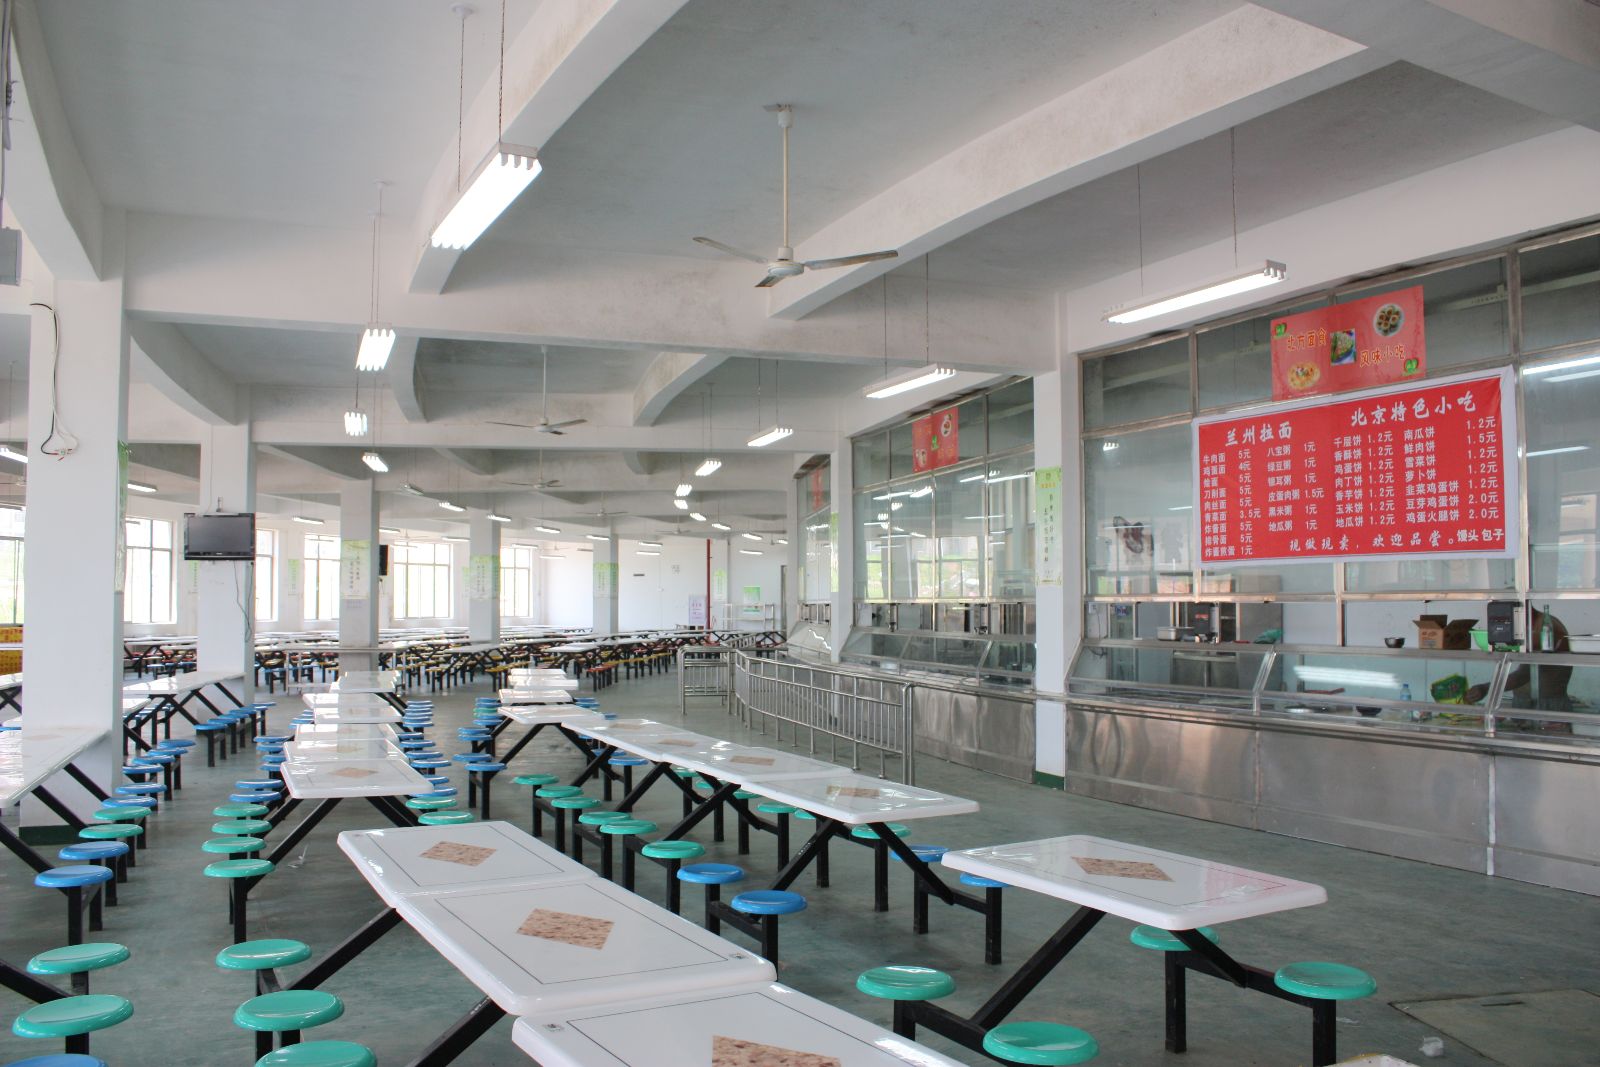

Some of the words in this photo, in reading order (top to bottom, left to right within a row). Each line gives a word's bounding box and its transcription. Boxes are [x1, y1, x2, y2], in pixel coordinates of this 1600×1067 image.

[1360, 345, 1406, 368] 风味小吃
[1351, 390, 1476, 427] 北京特色小吃
[1225, 421, 1292, 446] 兰州拉面
[1404, 427, 1435, 440] 南瓜饼
[1467, 416, 1495, 430] 1.2元
[1334, 435, 1361, 447] 千层饼
[1368, 431, 1392, 443] 1.2元
[1404, 441, 1435, 454] 鲜肉饼
[1467, 432, 1496, 445] 1.5元
[1268, 445, 1290, 456] 八宝粥
[1304, 442, 1316, 452] 1元
[1334, 449, 1362, 462] 香酥饼
[1368, 445, 1393, 457] 1.2元
[1468, 447, 1497, 459] 1.2元
[1203, 453, 1226, 464] 牛肉面
[1238, 449, 1251, 459] 5元
[1268, 460, 1291, 472] 绿豆粥
[1305, 457, 1316, 468] 1元
[1334, 462, 1362, 475] 鸡蛋饼
[1368, 459, 1393, 471] 1.2元
[1405, 469, 1436, 482] 萝卜饼
[1468, 461, 1498, 474] 1.2元
[1240, 474, 1251, 483] 5元
[1268, 475, 1291, 486] 银耳粥
[1305, 473, 1316, 483] 1元
[1335, 476, 1362, 488] 肉丁饼
[1369, 473, 1394, 484] 1.2元
[1204, 488, 1226, 499] 刀削面
[1240, 485, 1252, 495] 5元
[1335, 489, 1362, 501] 香芋饼
[1369, 486, 1394, 498] 1.2元
[1406, 481, 1459, 496] 韭菜鸡蛋饼
[1468, 477, 1498, 489] 1.2元
[1268, 489, 1300, 502] 皮蛋肉粥
[1305, 488, 1324, 499] 1.5元
[1406, 496, 1459, 510] 豆芽鸡蛋饼
[1468, 492, 1498, 504] 2.0元
[1204, 500, 1226, 511] 肉丝面
[1240, 498, 1252, 507] 5元
[1268, 505, 1292, 516] 黑米粥
[1306, 504, 1317, 514] 1元
[1336, 502, 1363, 514] 玉米饼
[1369, 500, 1395, 511] 1.2元
[1240, 508, 1261, 519] 3.5元
[1406, 509, 1459, 523] 鸡蛋火腿饼
[1469, 507, 1499, 519] 2.0元
[1240, 521, 1252, 531] 5元
[1268, 520, 1292, 532] 地瓜粥
[1306, 520, 1317, 530] 1元
[1336, 515, 1363, 528] 地瓜饼
[1369, 514, 1395, 525] 1.2元
[1241, 534, 1252, 543] 5元
[1457, 529, 1478, 542] 馒头
[1482, 529, 1504, 541] 包子
[1241, 546, 1252, 555] 1元
